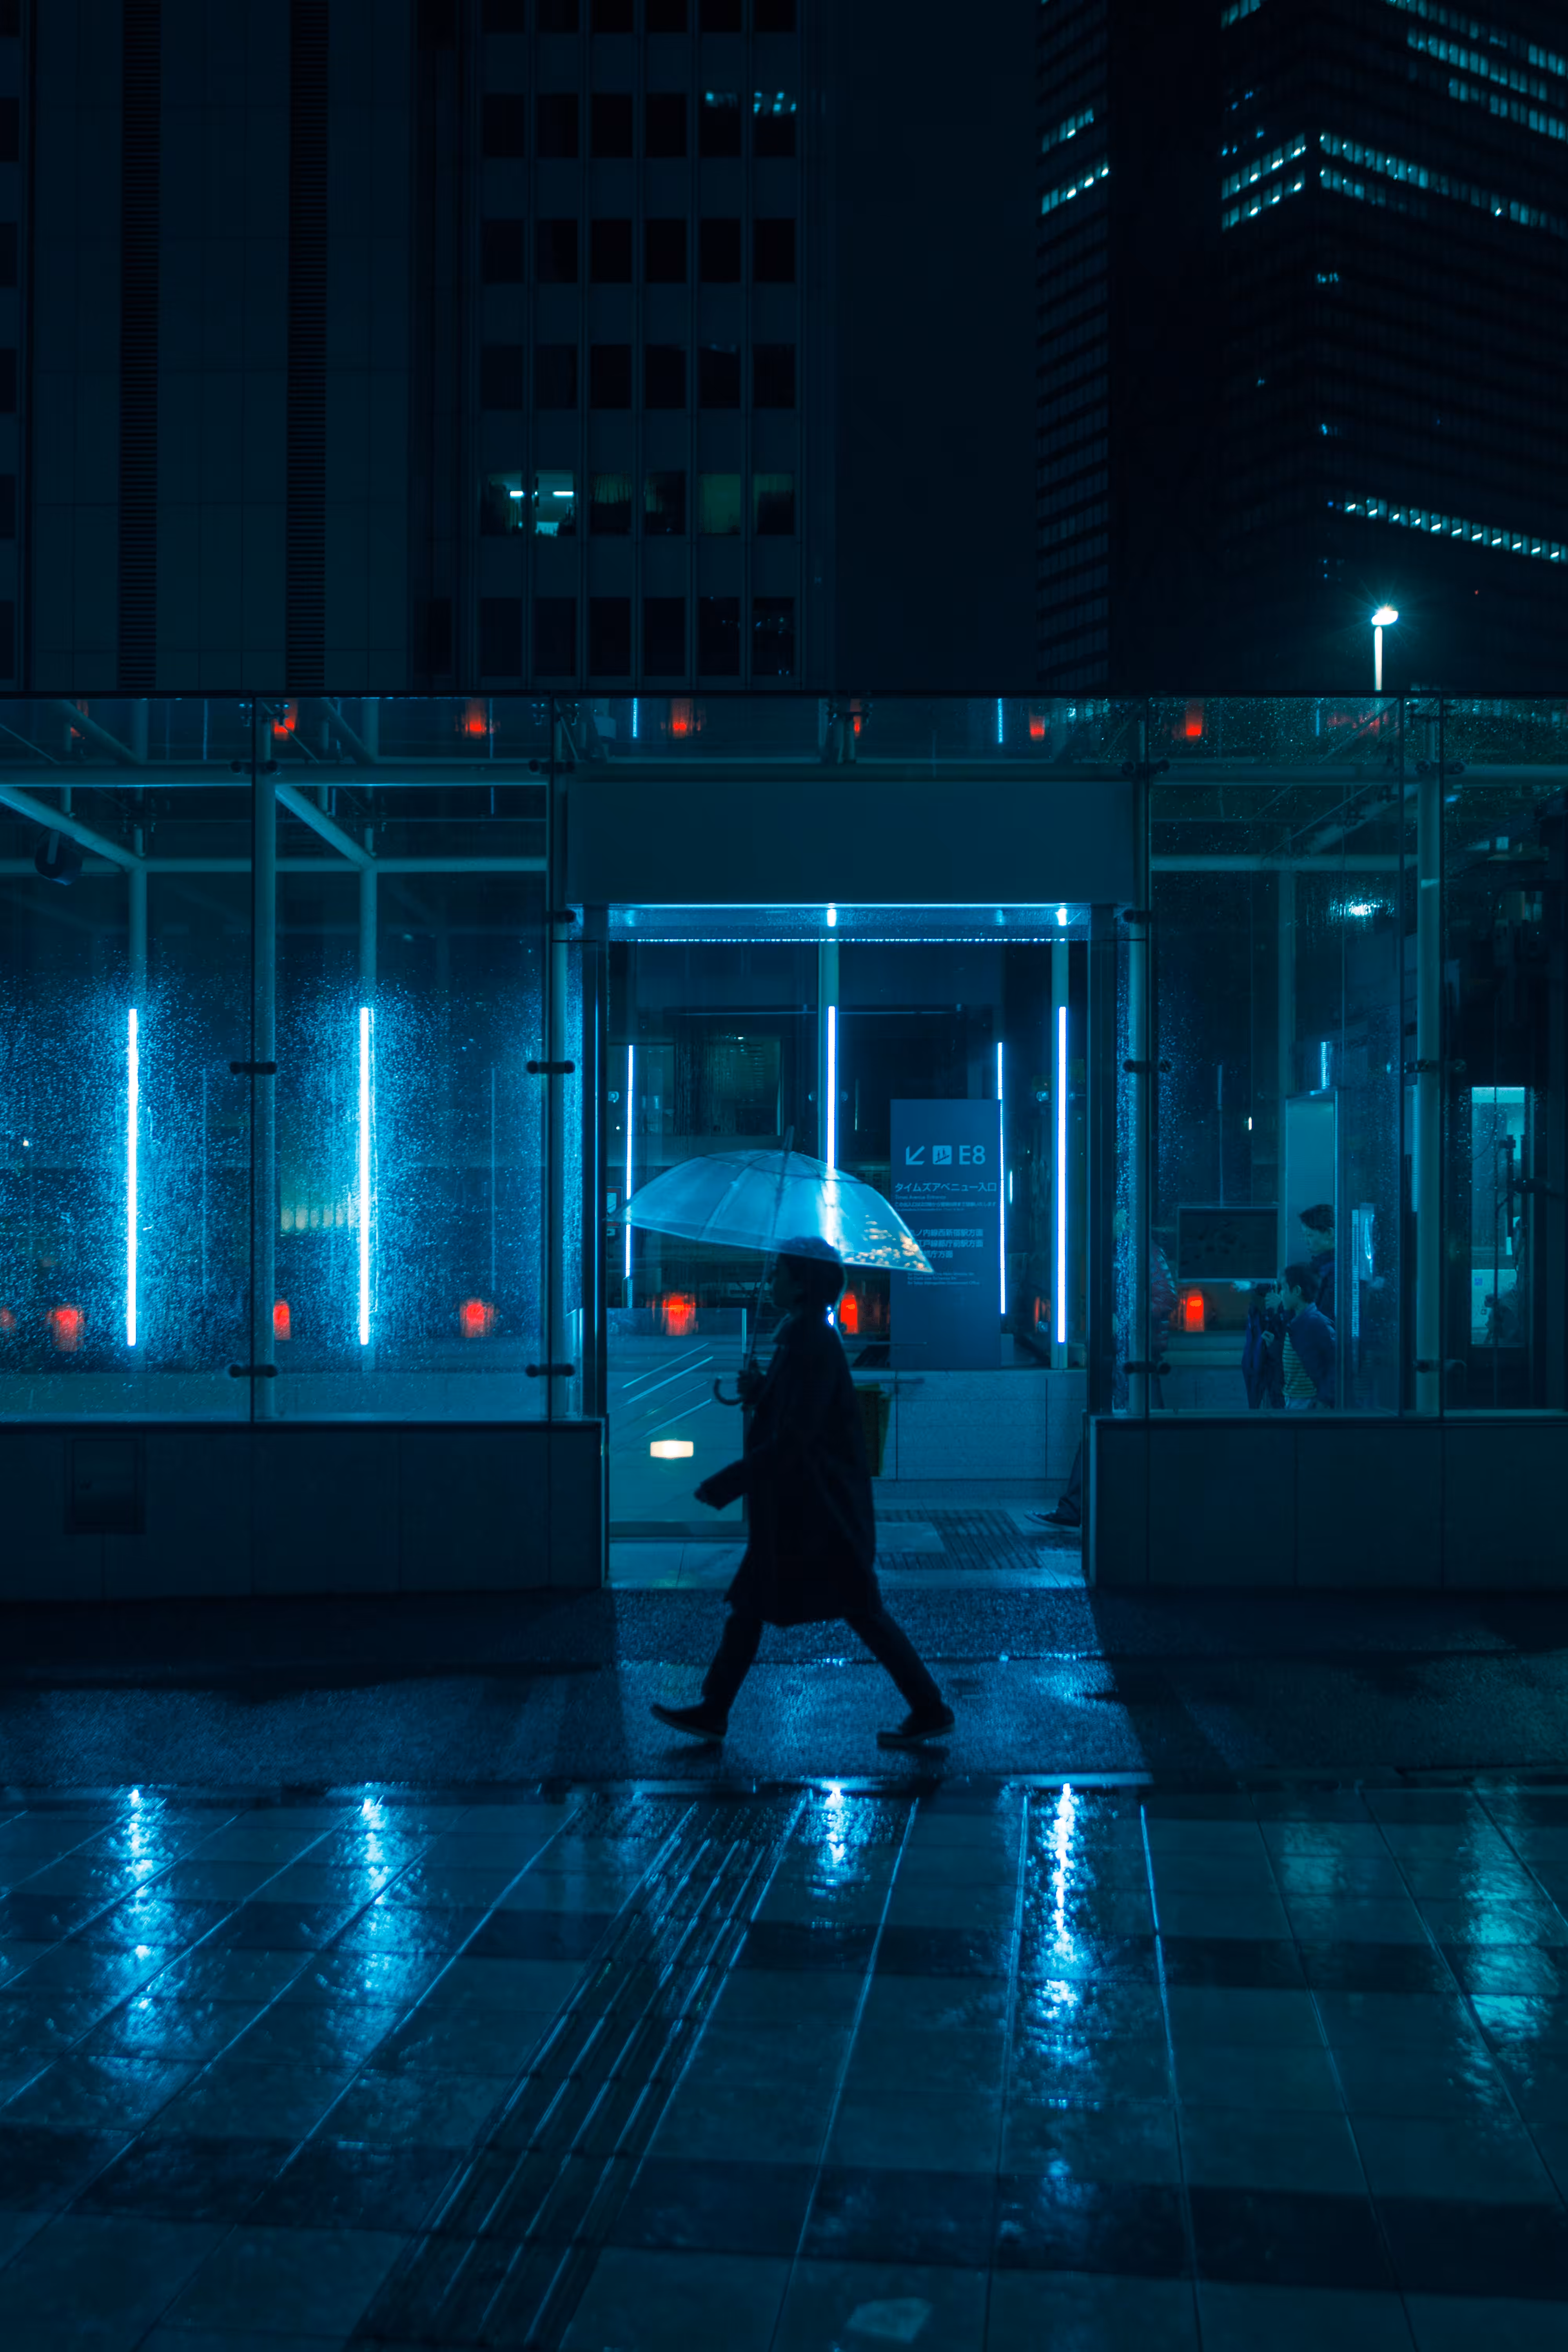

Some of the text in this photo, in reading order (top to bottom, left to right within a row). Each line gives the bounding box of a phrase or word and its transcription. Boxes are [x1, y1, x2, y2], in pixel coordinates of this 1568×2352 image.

[959, 1145, 985, 1165] E8
[895, 1182, 996, 1192] タイムズアベニュー入口
[916, 1240, 983, 1248] 江戸線都庁前駅方面
